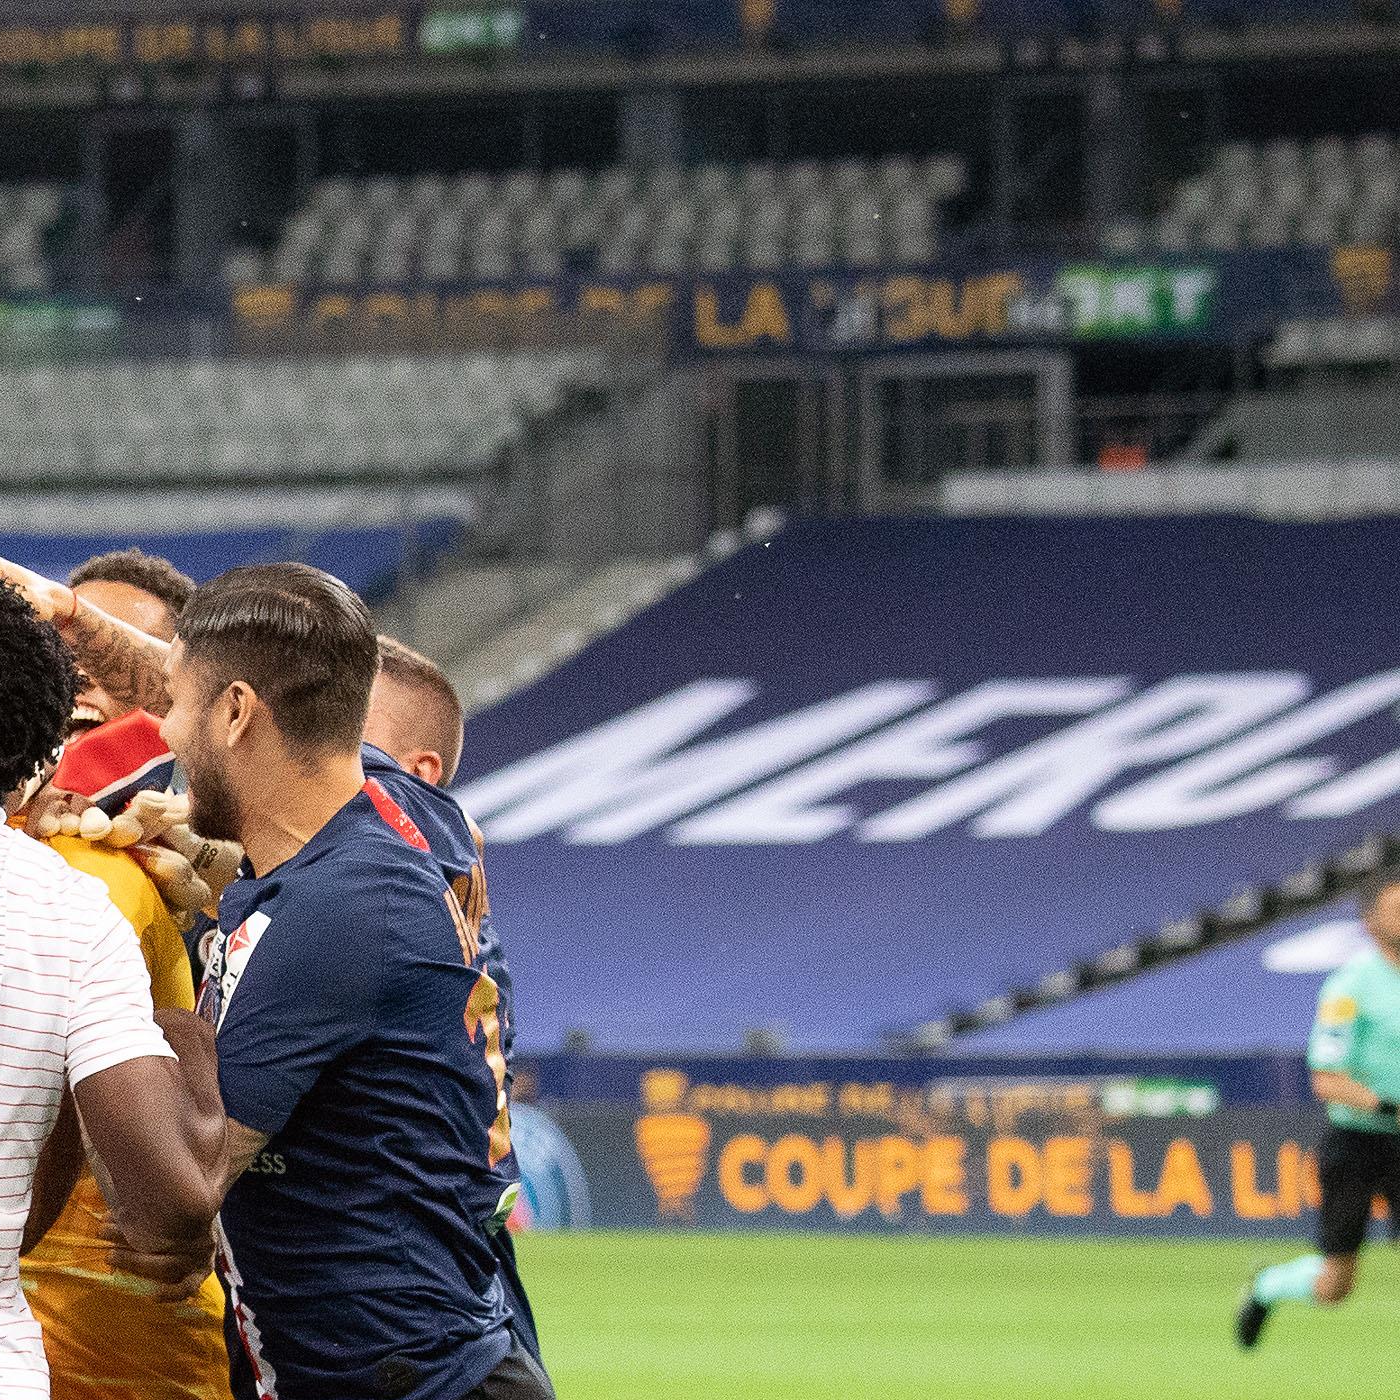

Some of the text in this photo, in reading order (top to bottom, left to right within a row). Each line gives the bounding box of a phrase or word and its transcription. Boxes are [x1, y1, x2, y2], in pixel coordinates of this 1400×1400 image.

[719, 1136, 968, 1218] COUPE
[987, 1136, 1094, 1218] DE
[1108, 1138, 1214, 1218] LA
